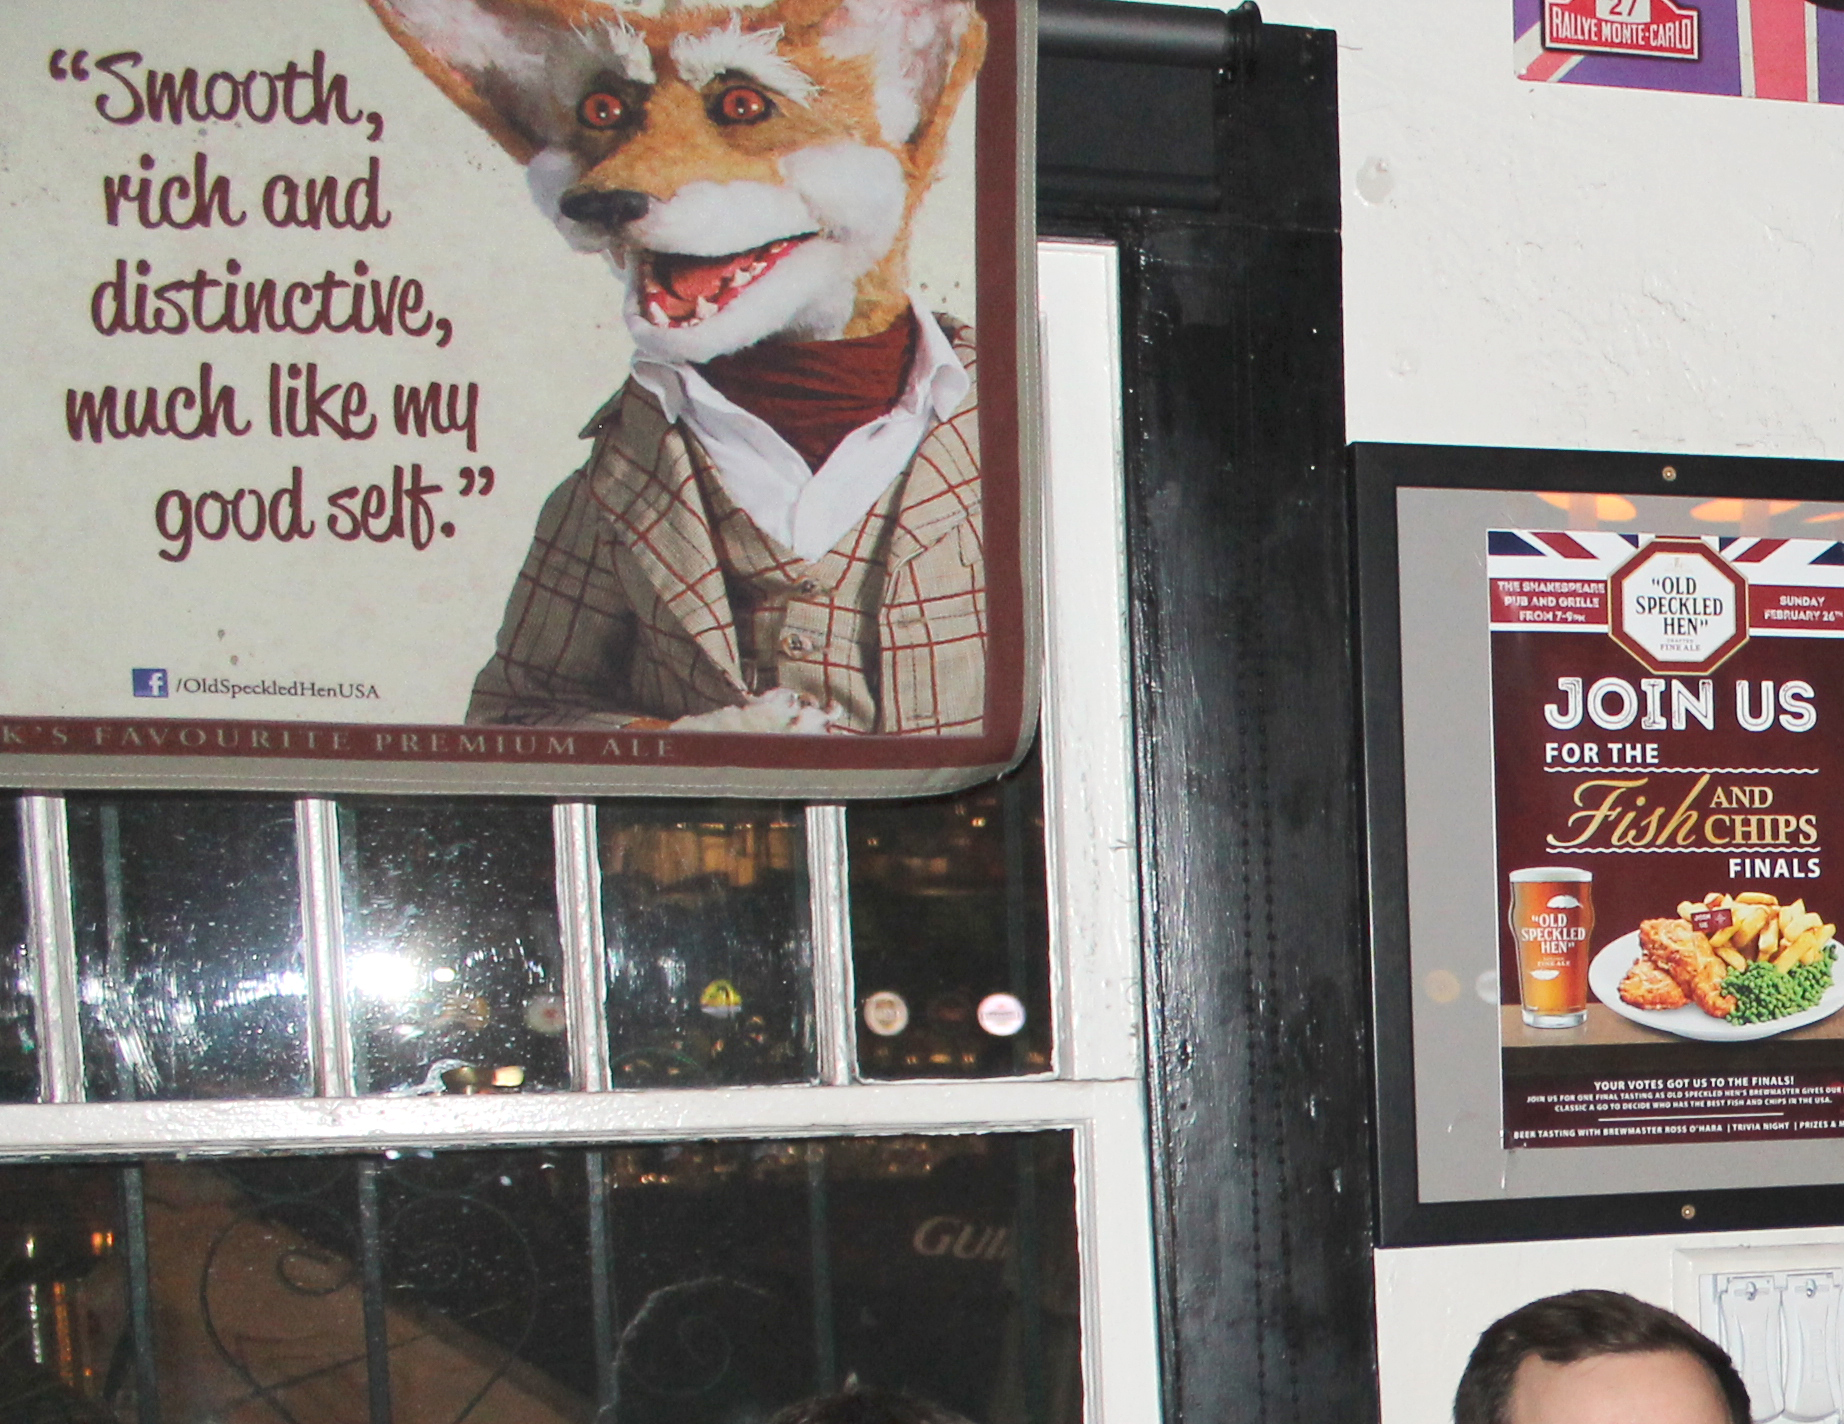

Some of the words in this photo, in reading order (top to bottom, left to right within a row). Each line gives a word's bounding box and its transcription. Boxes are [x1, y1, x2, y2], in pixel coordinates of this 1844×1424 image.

[1552, 6, 1598, 41] RALLYE
[1602, 19, 1692, 49] MONTE-CARLO
[103, 153, 246, 229] rich
[262, 156, 392, 230] and
[90, 260, 453, 347] distinctive,
[67, 362, 251, 442] much
[270, 363, 376, 439] like
[393, 381, 479, 452] my
[155, 465, 316, 562] good
[1498, 581, 1520, 592] THE
[1522, 582, 1605, 594] SHAKESPEARE
[1504, 596, 1528, 606] PUB
[1531, 597, 1556, 607] AND
[1558, 598, 1600, 608] GRILLE
[1636, 596, 1723, 616] SPECKLED
[1780, 596, 1825, 607] SUNDAY
[1520, 610, 1553, 621] FROM
[1764, 609, 1820, 621] FEBRUARY
[176, 678, 380, 699] /OldSpeckledHenUSA
[1544, 677, 1715, 730] JOIN
[1736, 679, 1818, 732] US
[95, 726, 350, 751] FAVOURITE
[375, 733, 576, 755] PREMIUM
[602, 738, 675, 758] ALE
[1545, 743, 1599, 764] FOR
[1607, 743, 1659, 764] THE
[1546, 773, 1710, 847] Fish
[1710, 786, 1773, 808] AND
[1704, 814, 1818, 845] CHIPS
[1729, 858, 1821, 878] FINALS
[1522, 927, 1586, 941] SPECKLED
[1594, 1081, 1625, 1091] YOUR
[1628, 1079, 1663, 1089] VOTES
[1667, 1079, 1690, 1088] GOT
[1693, 1078, 1707, 1088] US
[1710, 1078, 1725, 1087] TO
[1727, 1077, 1748, 1087] THE
[1752, 1076, 1794, 1085] FINALS!
[1620, 1092, 1652, 1100] TASTING
[1685, 1090, 1723, 1098] SPECKLED
[1749, 1088, 1800, 1096] BREWMASTER
[1802, 1087, 1824, 1095] GIVES
[1513, 1130, 1536, 1139] BEER
[1538, 1129, 1575, 1138] TASTING
[1578, 1128, 1600, 1137] WITH
[1603, 1126, 1662, 1136] BREWMASTER
[1732, 1123, 1761, 1131] TRIVIA
[1763, 1122, 1789, 1130] NIGHT
[1800, 1121, 1828, 1129] PRIZES
